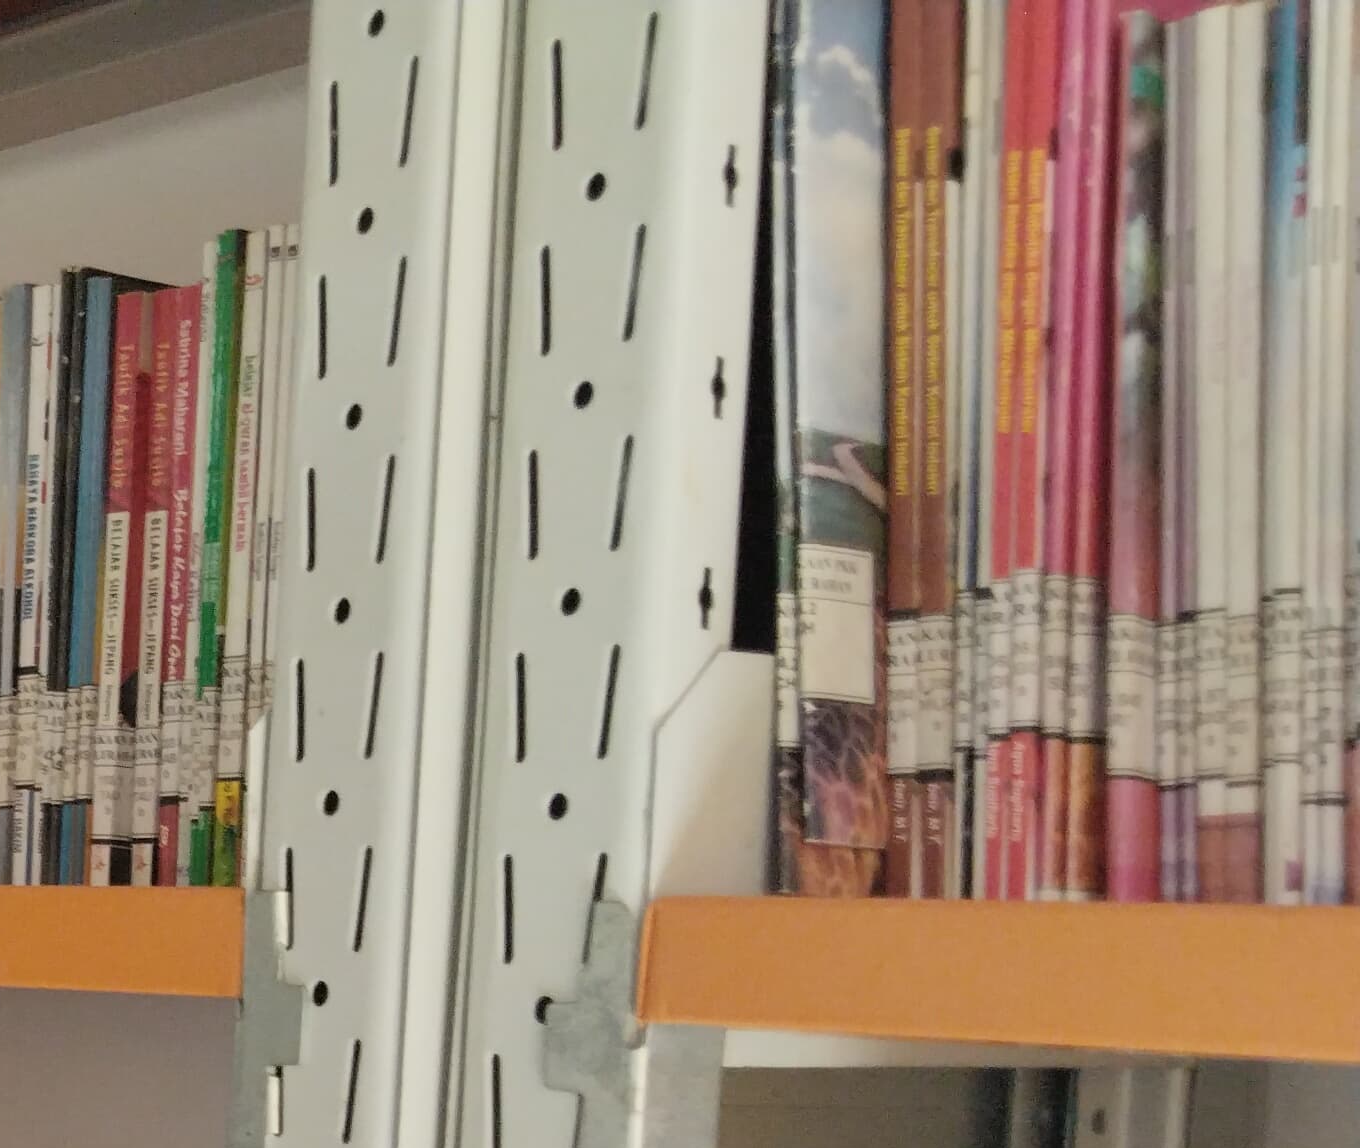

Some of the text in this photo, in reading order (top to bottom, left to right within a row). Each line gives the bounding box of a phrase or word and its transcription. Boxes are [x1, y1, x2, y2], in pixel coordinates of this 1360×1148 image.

[108, 578, 120, 619] SUKSES
[146, 578, 159, 618] SUKSES
[105, 633, 118, 675] JEPANG
[143, 633, 156, 675] JEPANG
